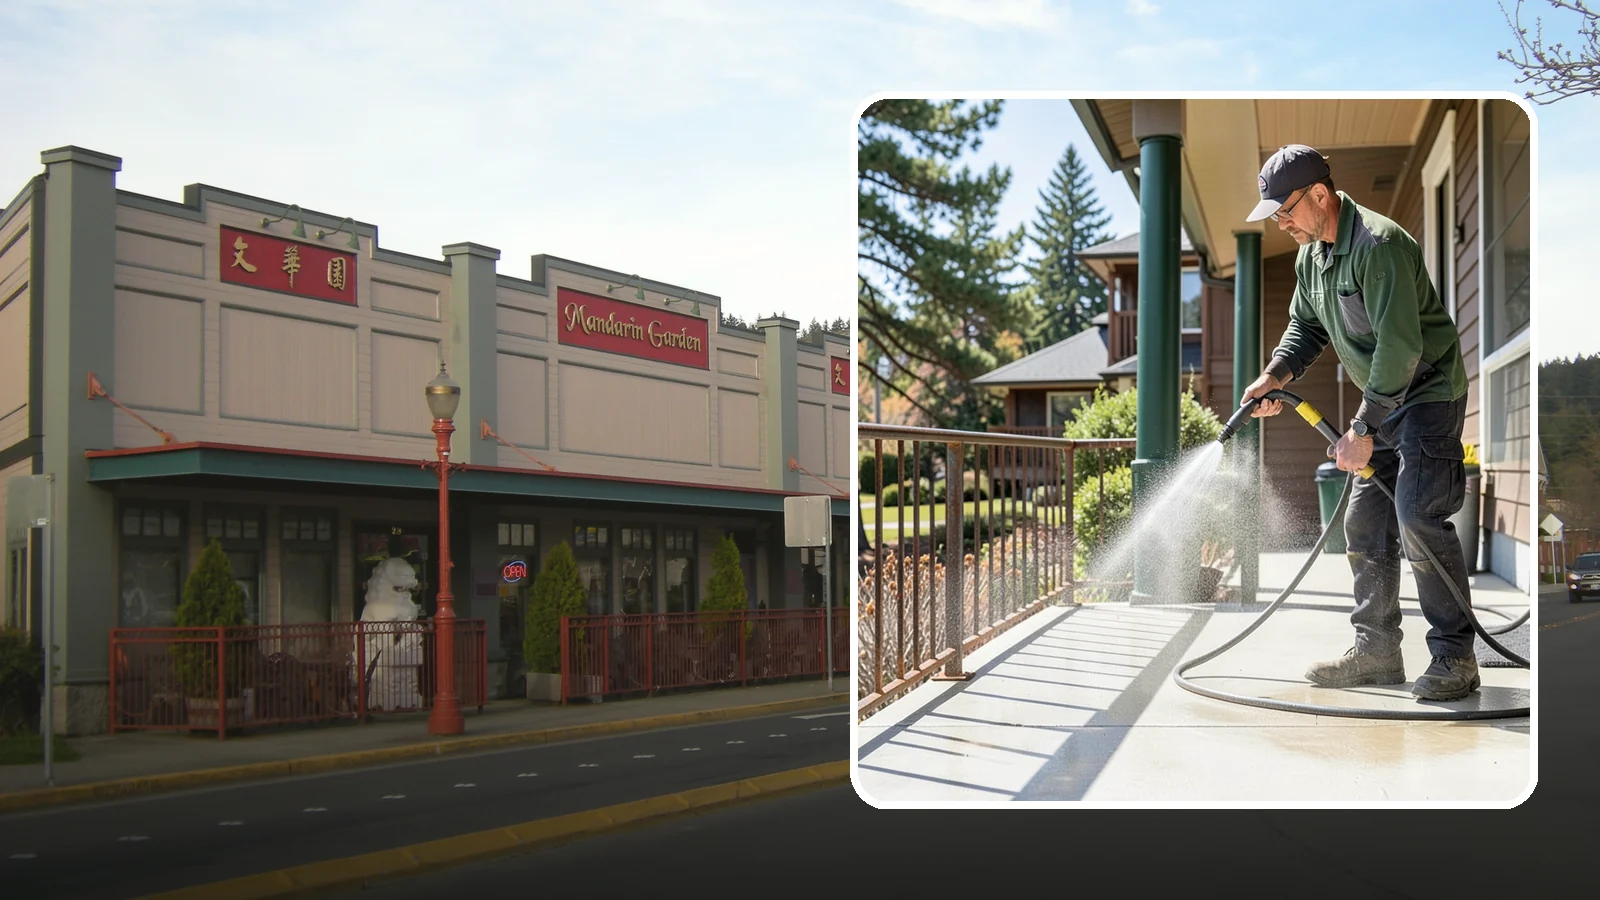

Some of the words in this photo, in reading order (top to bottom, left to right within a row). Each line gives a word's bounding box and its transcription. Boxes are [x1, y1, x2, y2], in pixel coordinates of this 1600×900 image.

[231, 236, 346, 291] 文華園
[564, 302, 644, 341] Mandarin
[648, 320, 701, 352] Garden
[503, 565, 526, 578] OPEN
